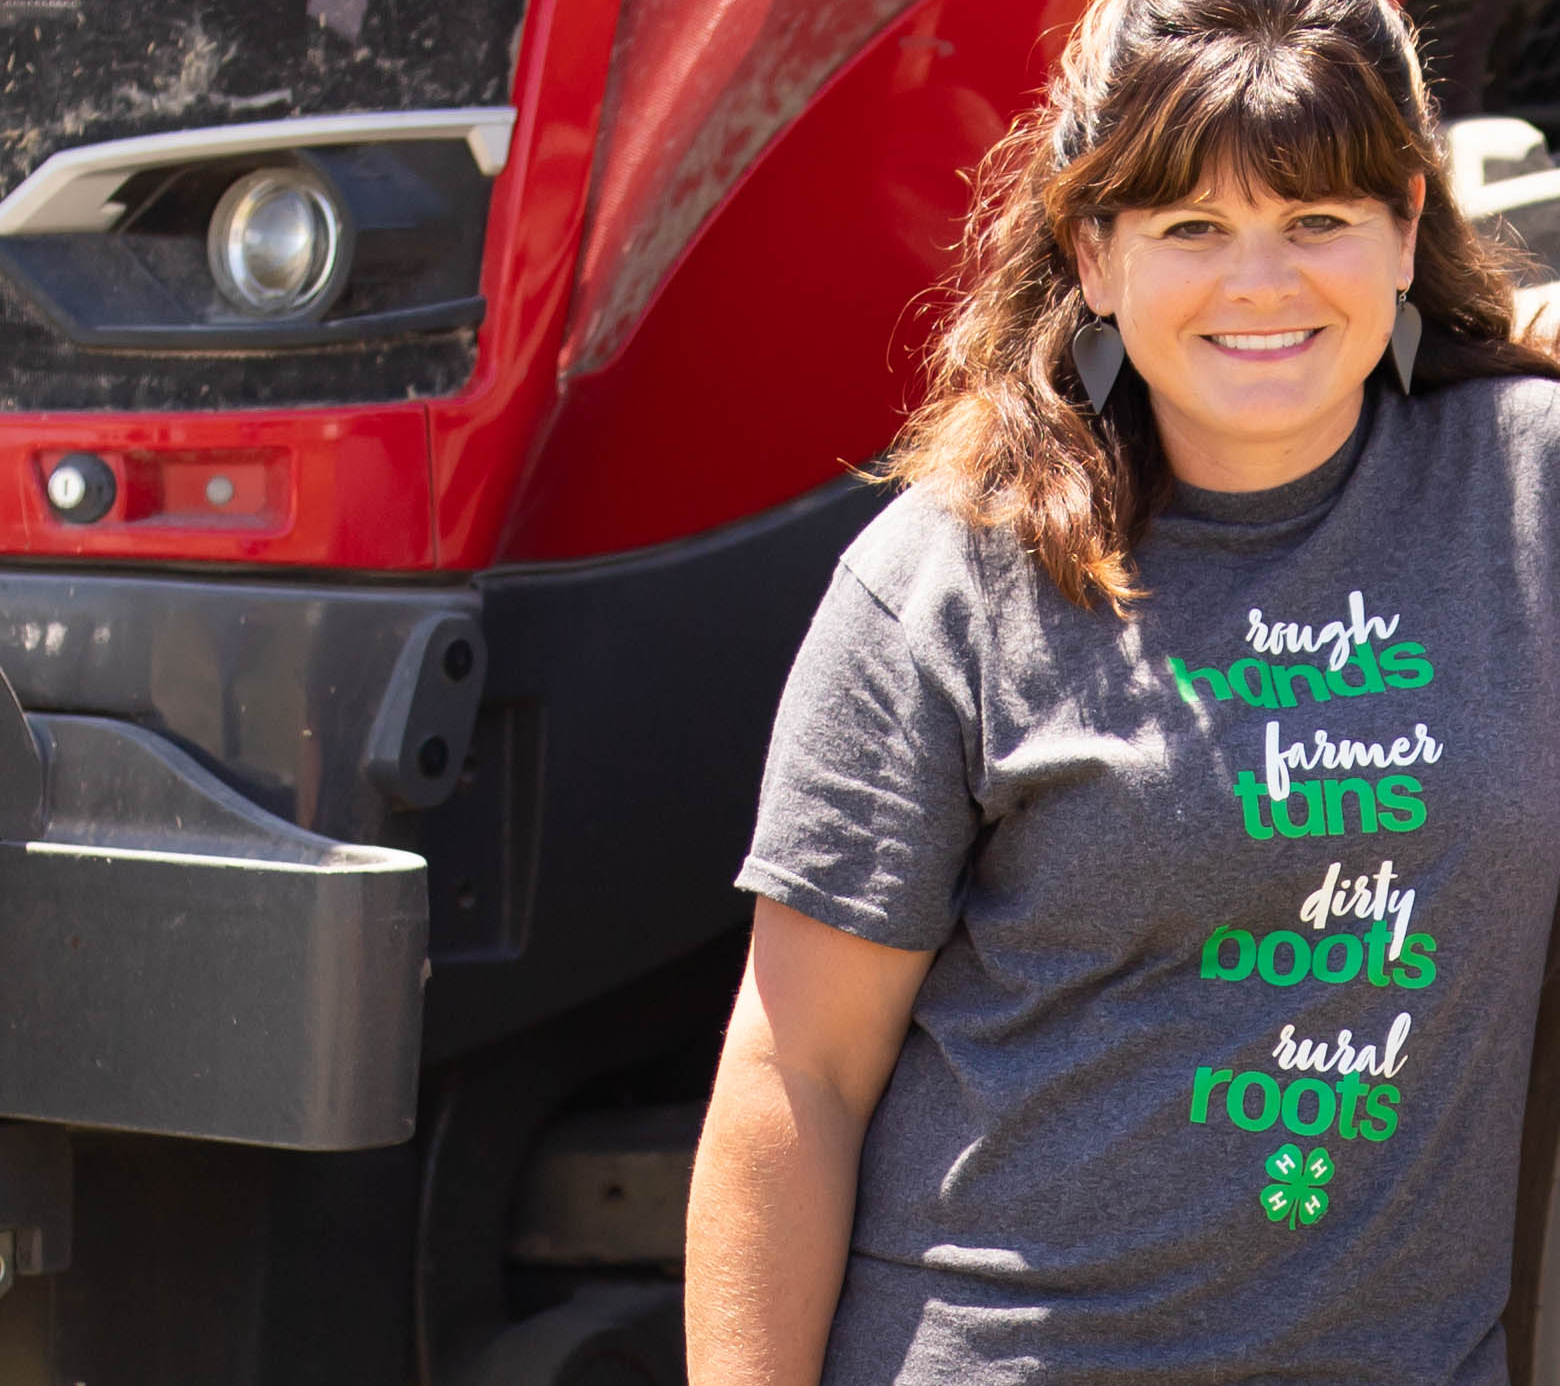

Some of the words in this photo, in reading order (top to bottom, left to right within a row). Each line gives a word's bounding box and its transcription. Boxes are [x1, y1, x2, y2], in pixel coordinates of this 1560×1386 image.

[1246, 590, 1400, 671] rough
[1168, 641, 1434, 709] hands
[1265, 721, 1443, 801] farmer
[1233, 771, 1428, 839] tans
[1300, 860, 1415, 960] dirty
[1200, 919, 1437, 988] boots
[1272, 1011, 1412, 1077] rural
[1189, 1065, 1400, 1141] roots
[1275, 1153, 1296, 1175] H
[1310, 1158, 1328, 1179] H
[1268, 1191, 1287, 1211] H
[1305, 1195, 1321, 1215] H
